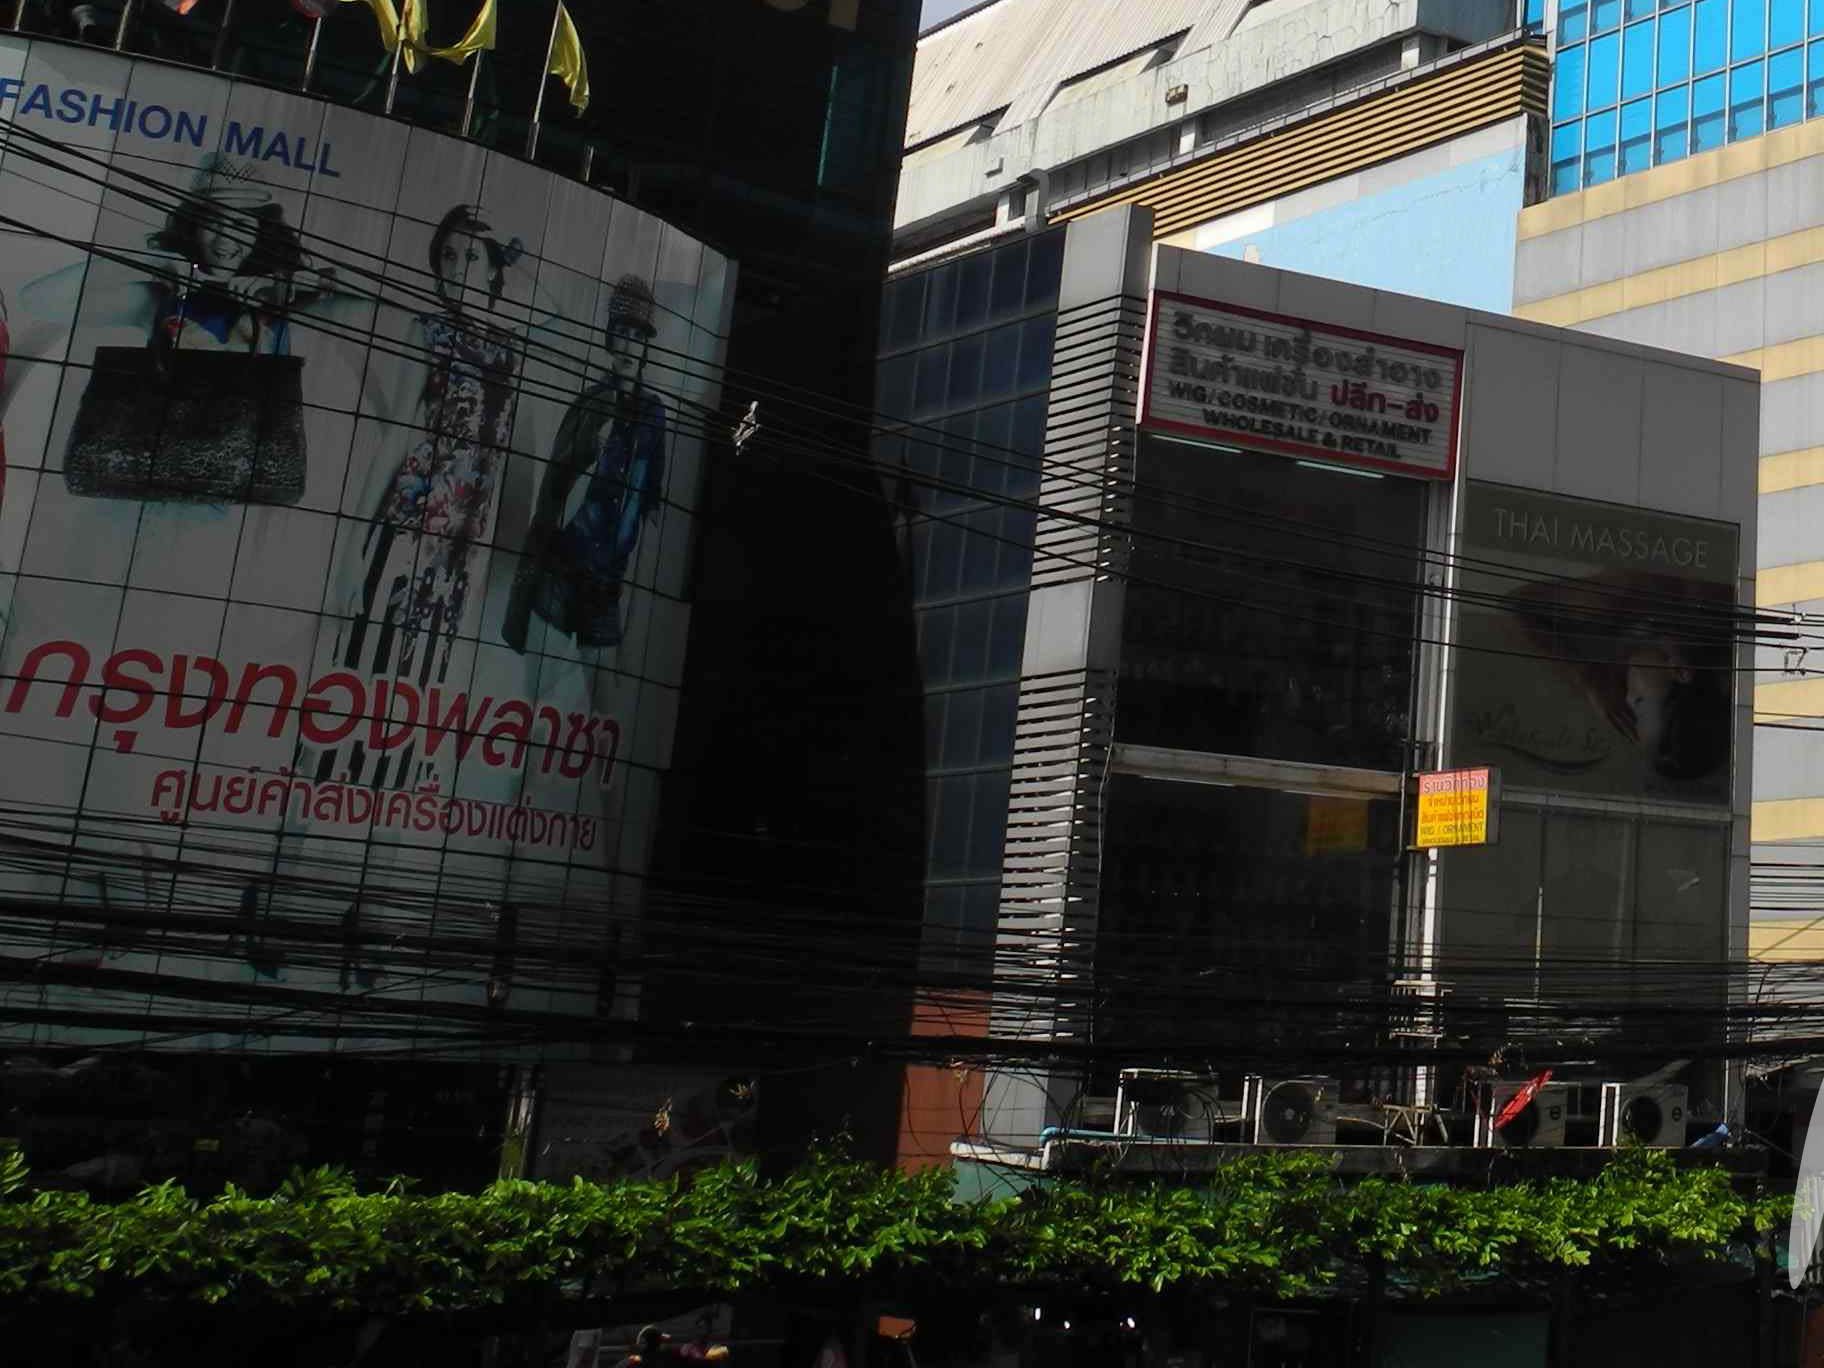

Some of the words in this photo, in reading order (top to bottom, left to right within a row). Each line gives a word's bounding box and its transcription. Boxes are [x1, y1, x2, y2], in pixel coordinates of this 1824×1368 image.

[0, 77, 208, 148] FASHION
[224, 121, 342, 179] MALL
[1202, 408, 1318, 449] WHOLESALE
[1341, 435, 1401, 460] RETAIL
[1491, 506, 1559, 547] THAI
[1568, 519, 1712, 570] MASSAGE
[4, 640, 620, 785] กรุงทองพลาซา
[150, 764, 598, 851] ศูนย์ค้าส่งเครื่องแต่งกาย
